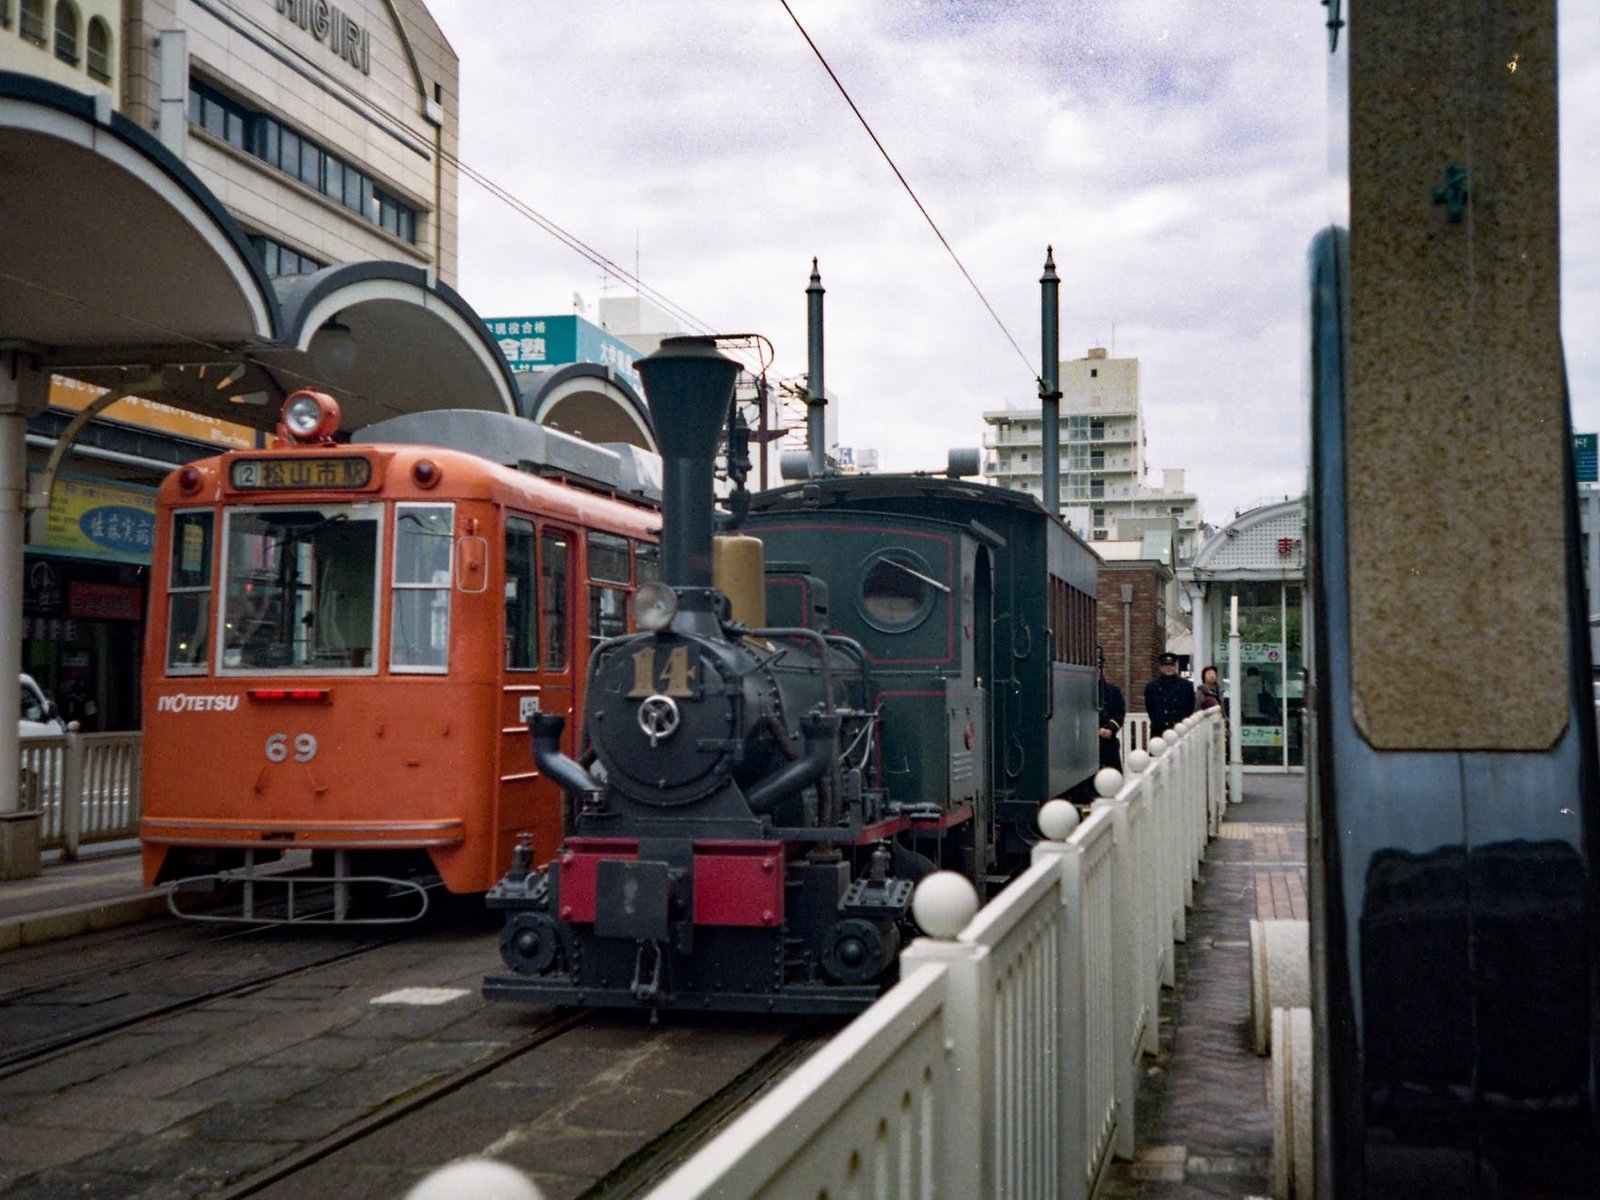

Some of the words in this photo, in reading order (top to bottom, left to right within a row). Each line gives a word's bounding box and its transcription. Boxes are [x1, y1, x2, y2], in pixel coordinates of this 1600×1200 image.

[264, 461, 367, 486] 松山市駅
[628, 646, 696, 697] 14
[157, 693, 239, 712] IYOTETSU
[264, 732, 318, 763] 69
